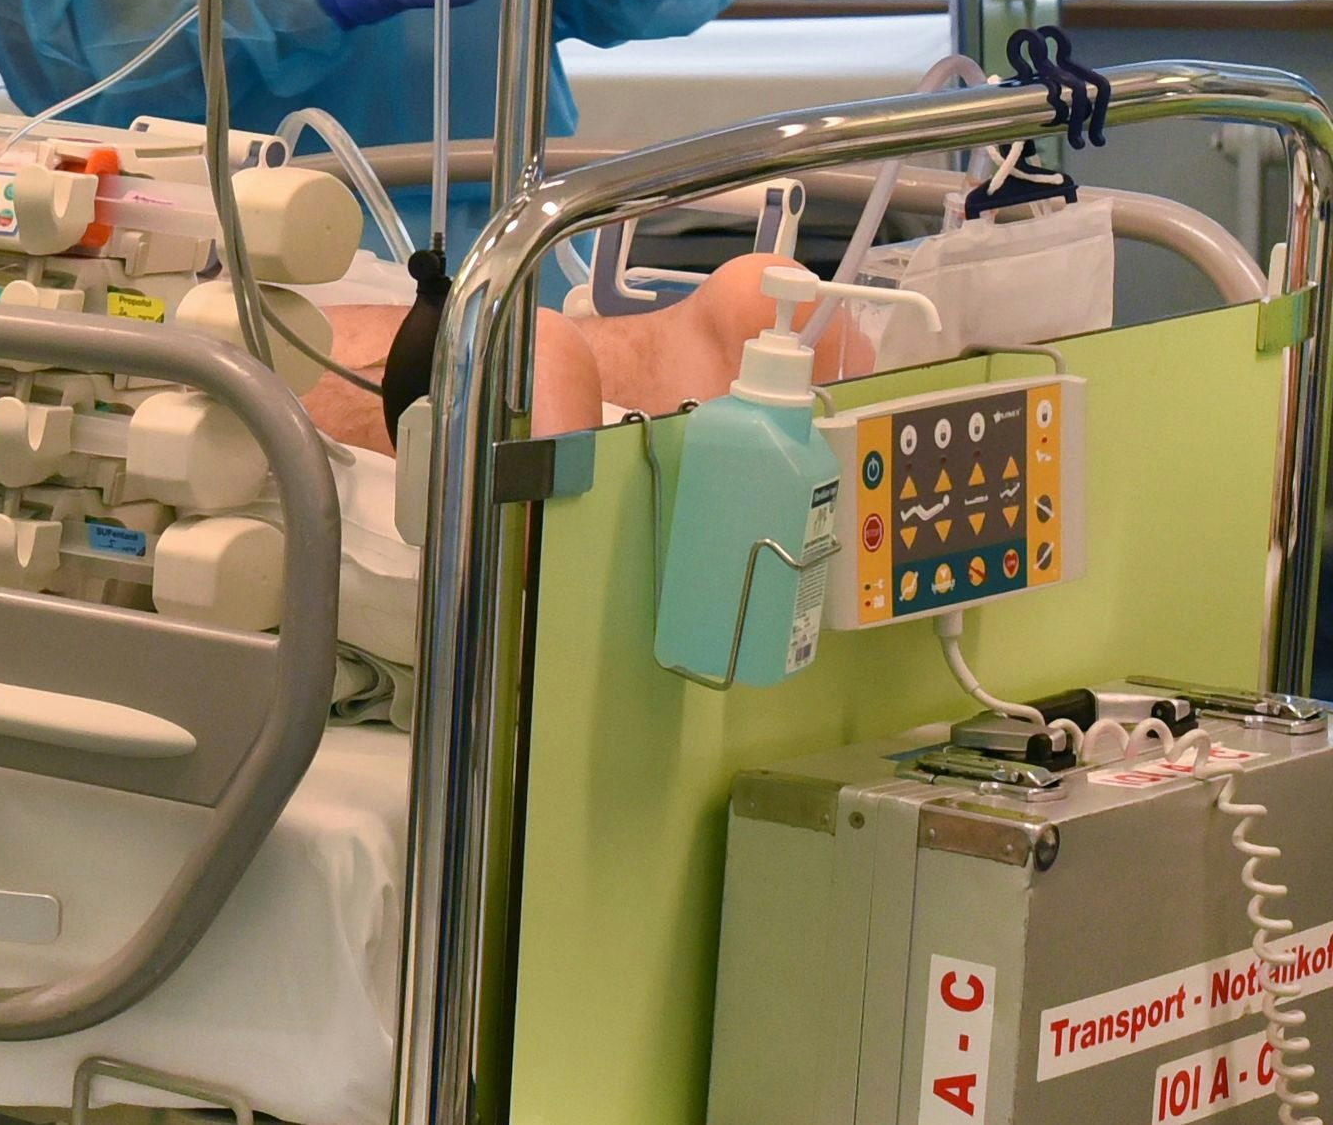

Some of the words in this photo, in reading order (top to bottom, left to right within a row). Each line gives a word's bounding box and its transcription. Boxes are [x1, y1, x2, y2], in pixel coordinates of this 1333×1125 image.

[940, 970, 985, 1013] C
[1050, 984, 1187, 1057] Transport
[1193, 995, 1202, 1005] -
[932, 1073, 977, 1117] A
[1208, 1056, 1230, 1104] A
